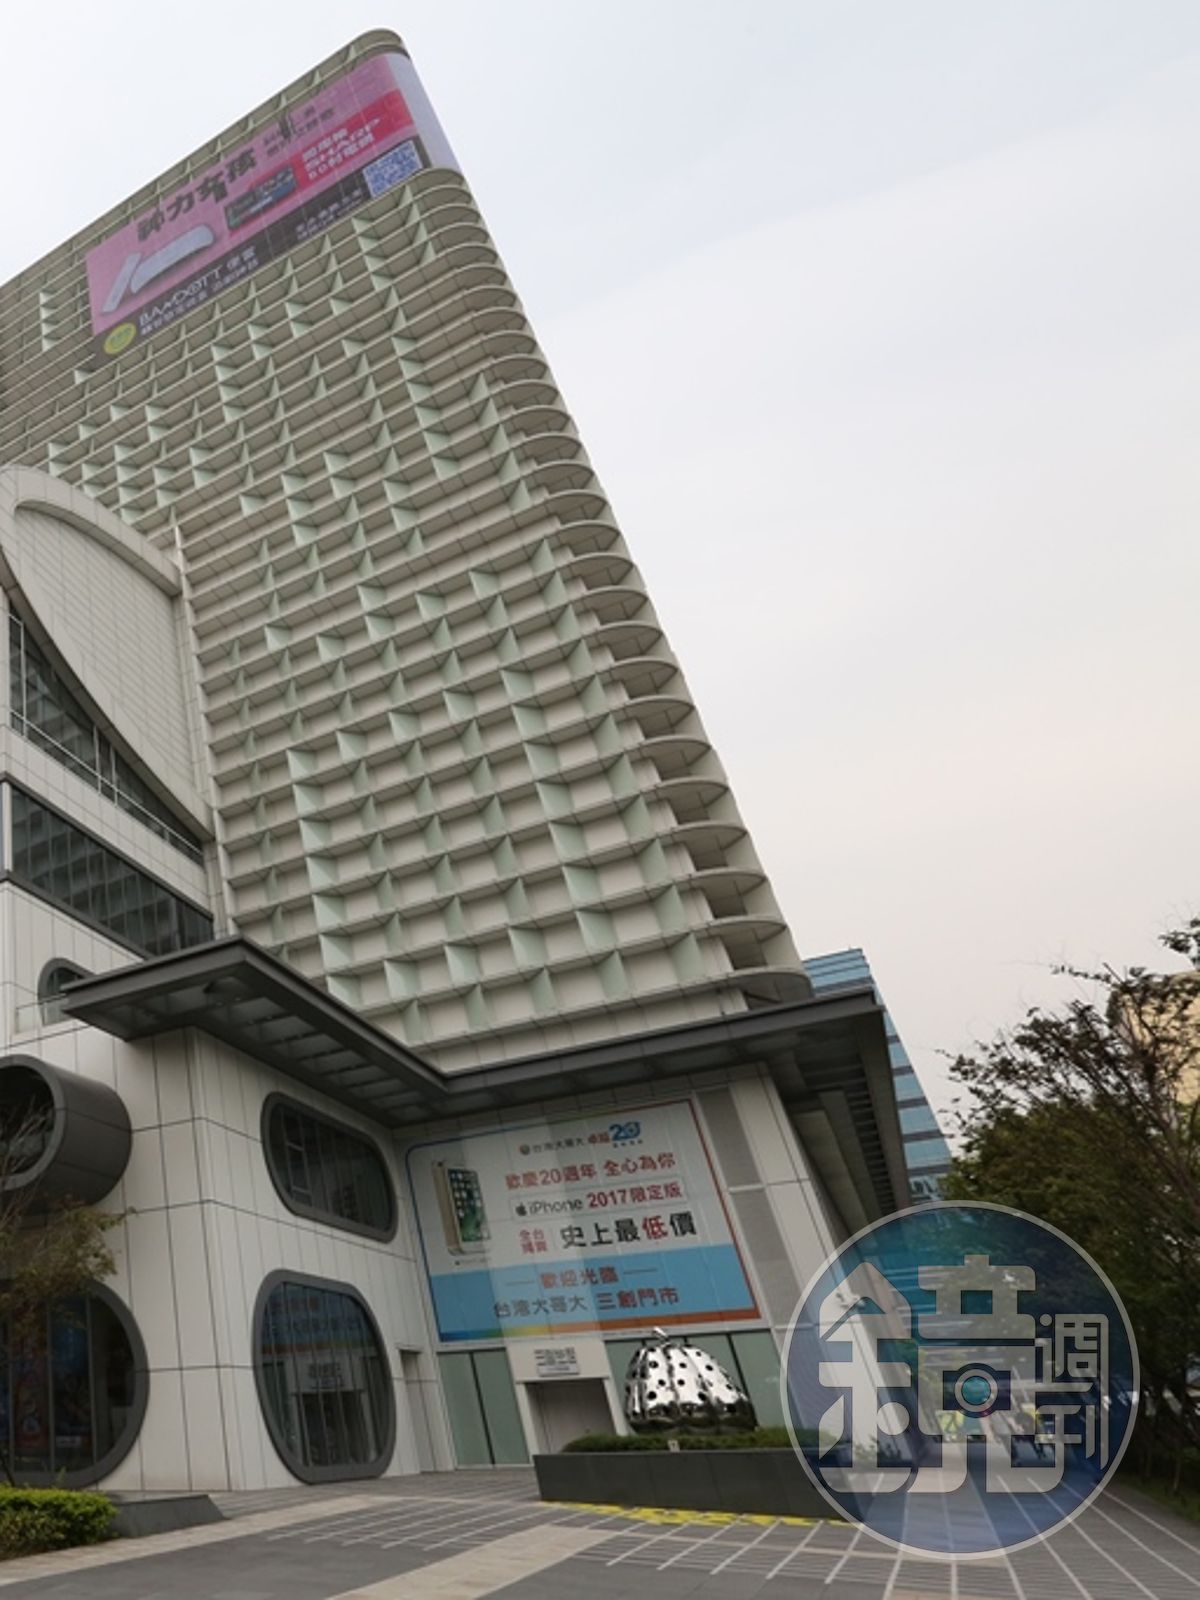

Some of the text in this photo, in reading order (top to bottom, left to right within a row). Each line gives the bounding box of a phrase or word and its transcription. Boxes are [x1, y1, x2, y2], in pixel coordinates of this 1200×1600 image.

[529, 1199, 583, 1215] iPhone
[560, 1211, 697, 1249] 史上最低價
[540, 1265, 619, 1290] 歡迎光臨
[494, 1287, 680, 1319] 台灣大哥大 三創門市
